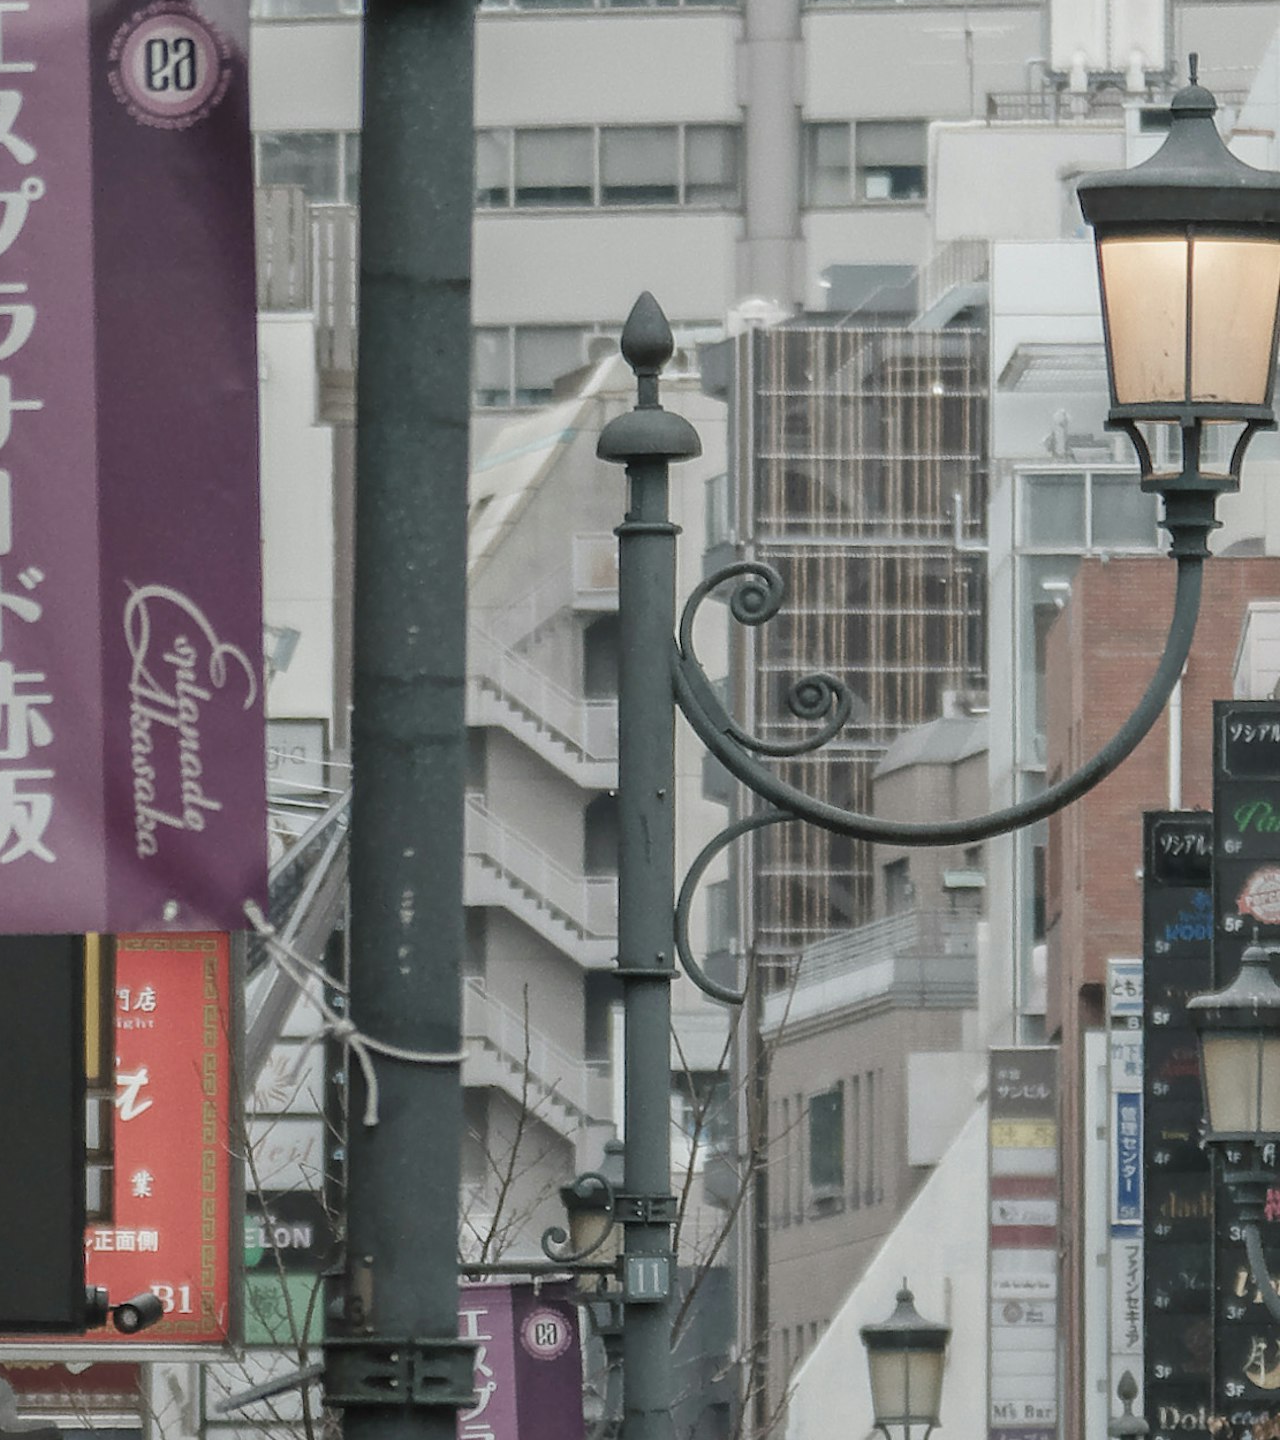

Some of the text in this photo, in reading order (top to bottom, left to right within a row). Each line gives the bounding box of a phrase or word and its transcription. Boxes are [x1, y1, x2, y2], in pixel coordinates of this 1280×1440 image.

[85, 1229, 160, 1253] 正面側
[149, 1283, 194, 1315] B1
